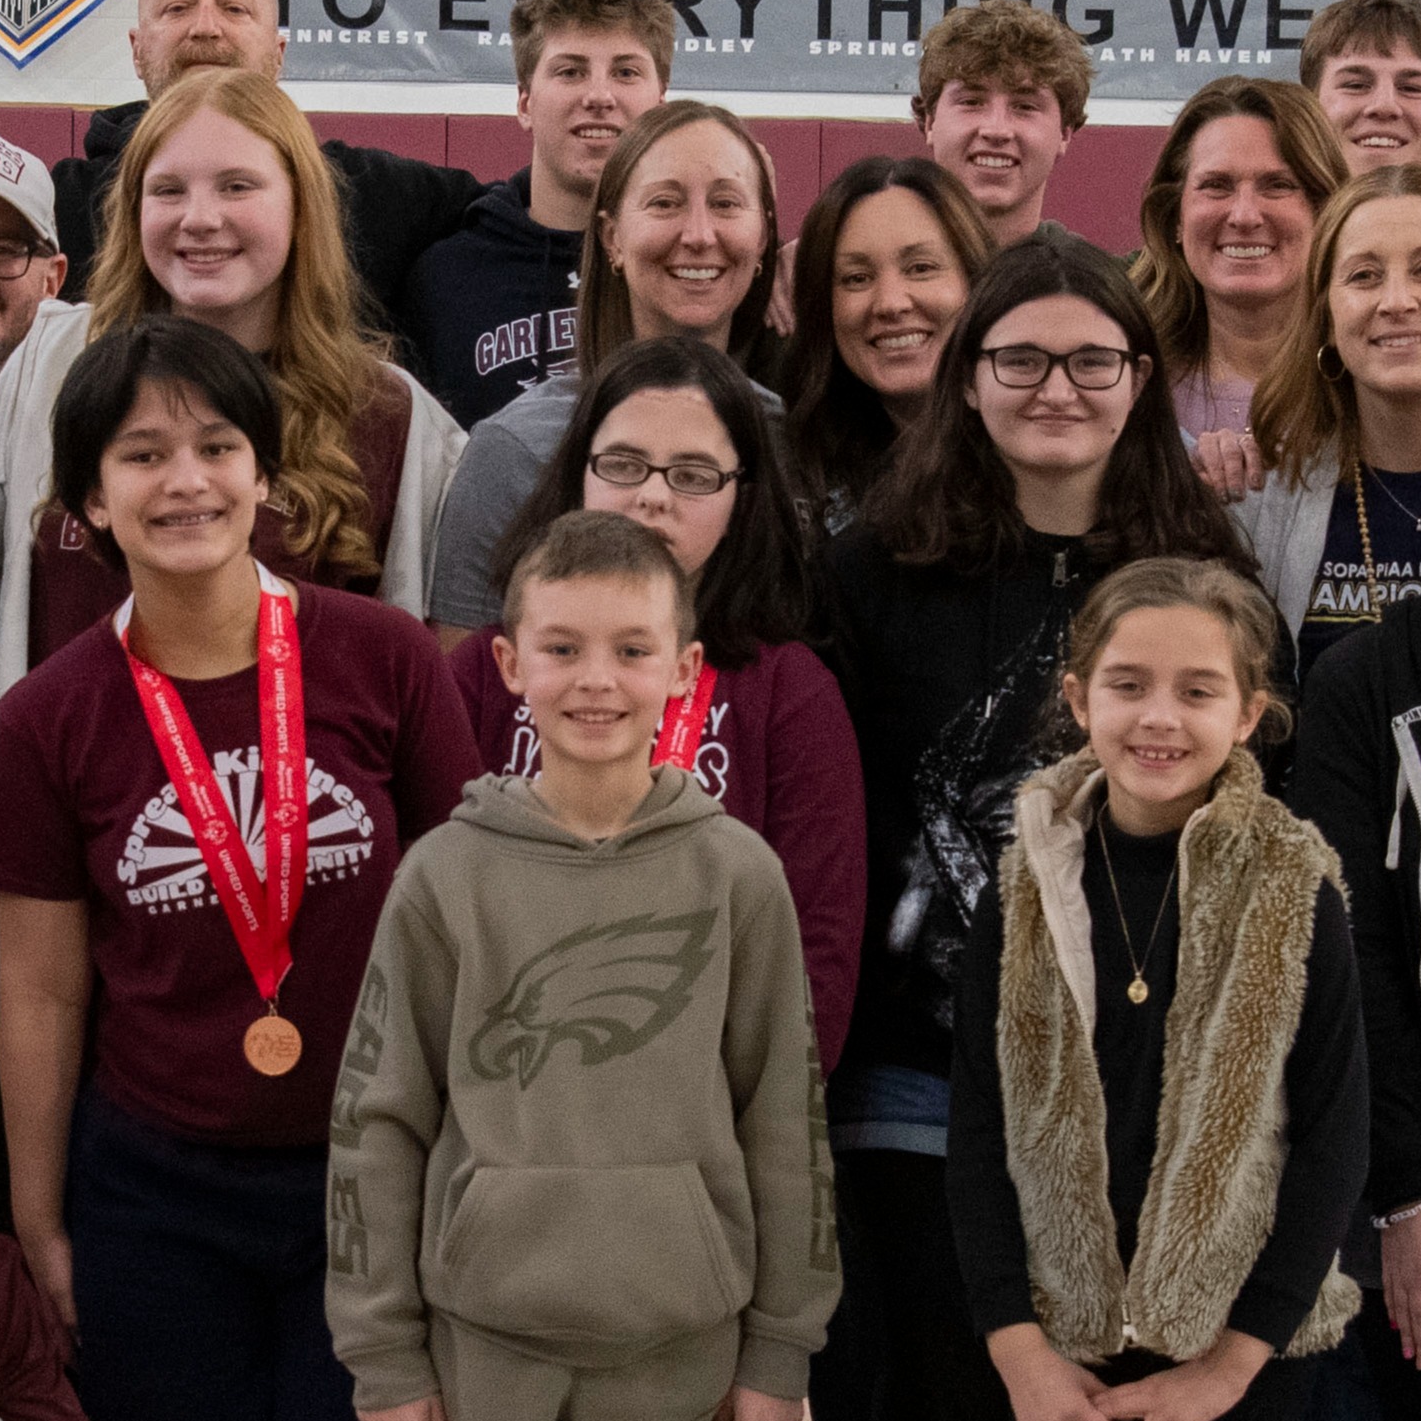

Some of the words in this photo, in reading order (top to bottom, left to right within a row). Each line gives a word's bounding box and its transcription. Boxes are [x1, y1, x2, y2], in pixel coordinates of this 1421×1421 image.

[279, 28, 428, 45] ENNCREST
[809, 40, 923, 57] SPRING
[1176, 48, 1273, 64] HAVEN
[1323, 561, 1367, 578] SOPA
[274, 668, 290, 715] UNIFIED
[155, 693, 178, 735] UNIFIED
[170, 732, 194, 776] SPORTS
[276, 716, 290, 754] SPORTS
[280, 834, 291, 877] UNIFIED
[127, 878, 205, 905] BUILD
[218, 849, 242, 892] UNIFIED
[236, 888, 259, 931] SPORTS
[280, 878, 289, 921] SPORTS
